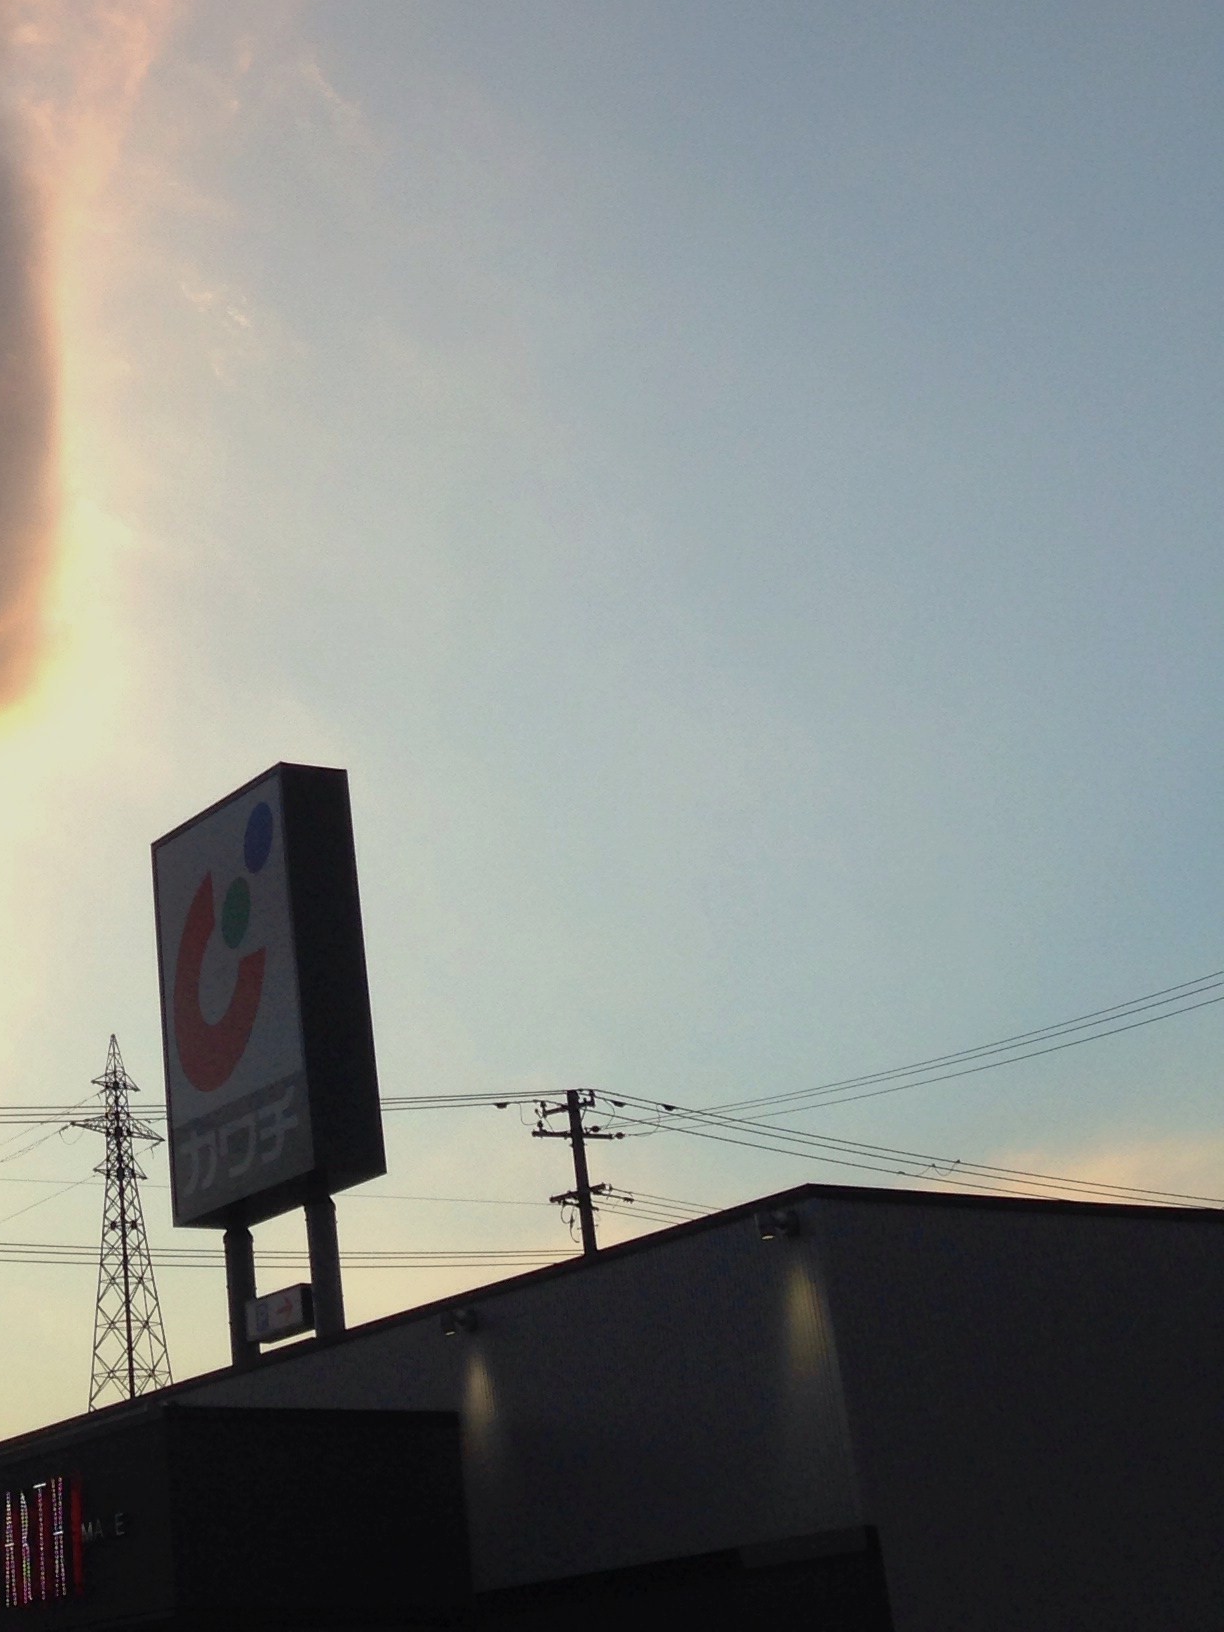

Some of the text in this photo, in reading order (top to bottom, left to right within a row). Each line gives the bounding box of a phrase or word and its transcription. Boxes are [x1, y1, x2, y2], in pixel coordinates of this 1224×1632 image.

[179, 1084, 299, 1198] カワチ
[81, 1511, 125, 1542] MAE
